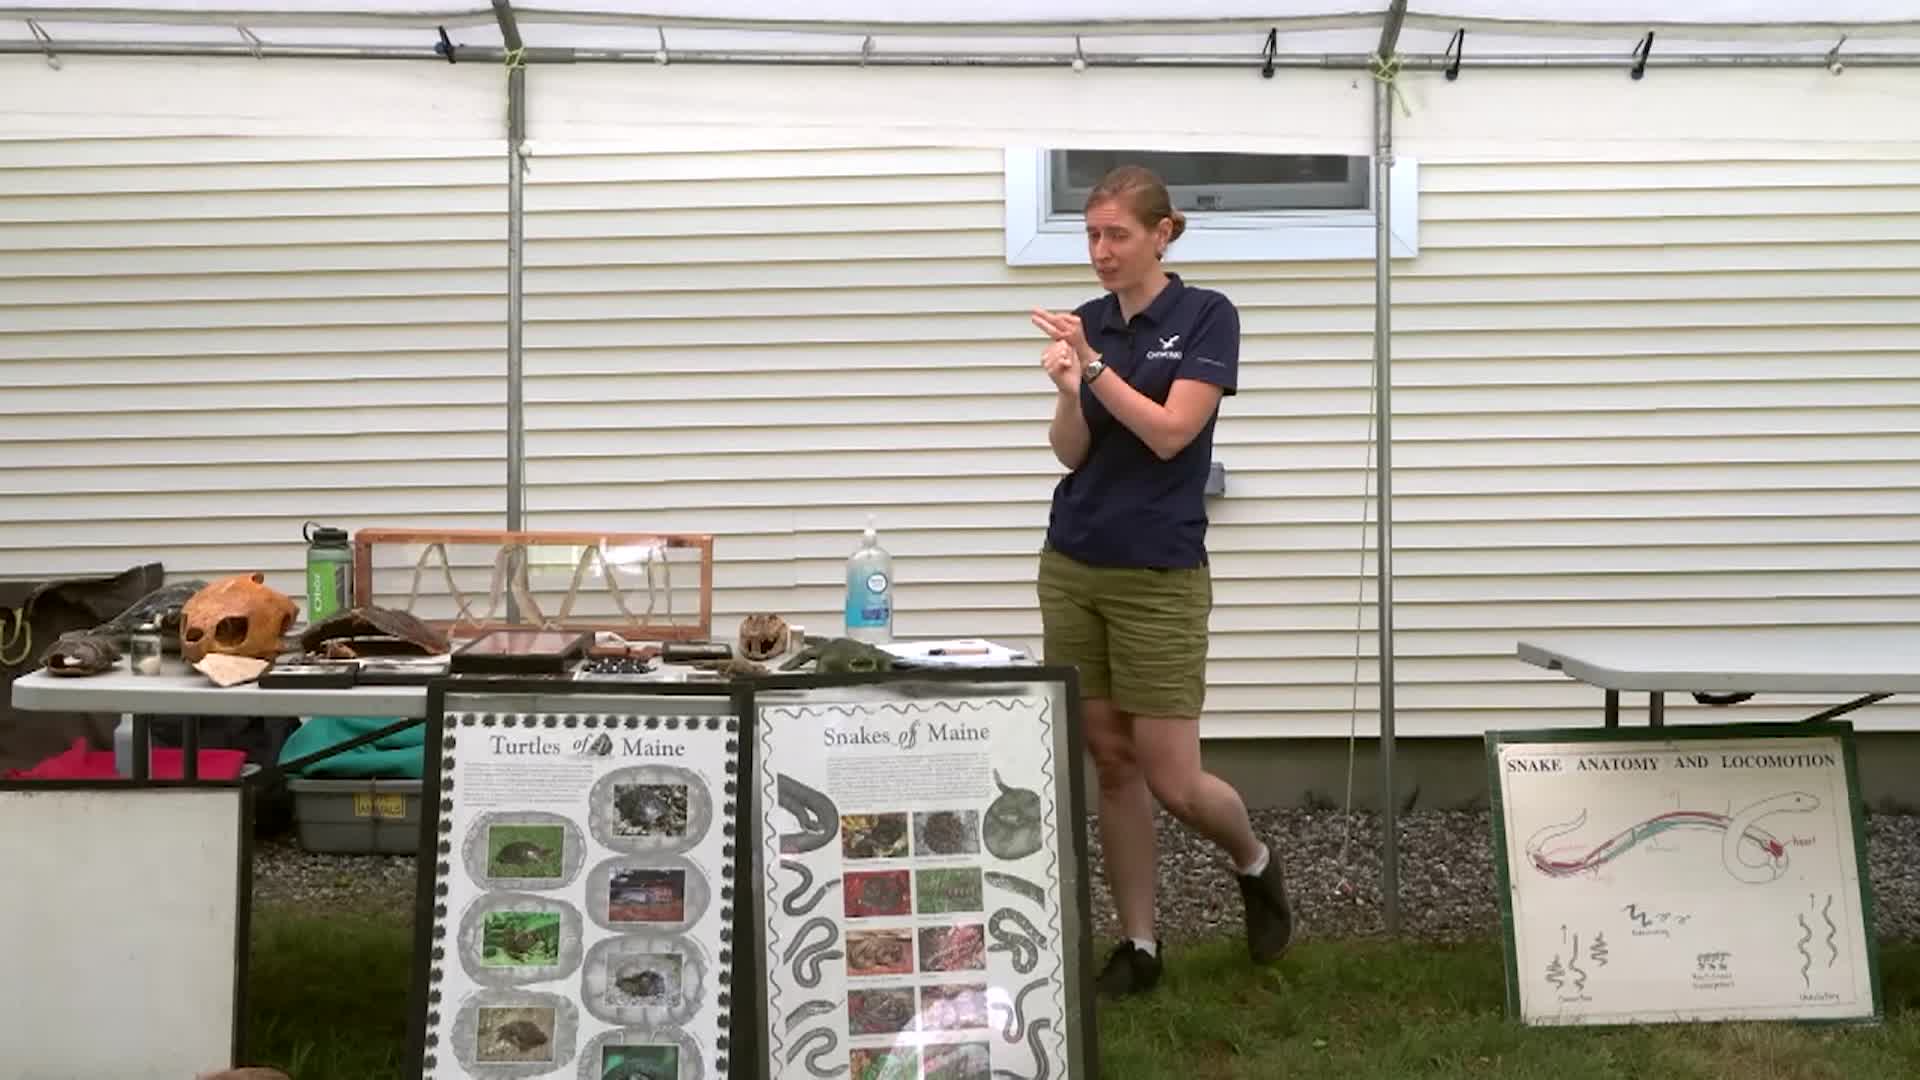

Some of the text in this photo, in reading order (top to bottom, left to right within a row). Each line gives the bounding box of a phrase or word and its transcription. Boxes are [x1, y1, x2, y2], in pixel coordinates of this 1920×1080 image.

[824, 719, 990, 750] Snakes of Maine
[490, 735, 561, 755] Turtles
[623, 737, 685, 757] Maine
[1507, 754, 1836, 773] SNAKE ANATOMY AND LOCOMOTION
